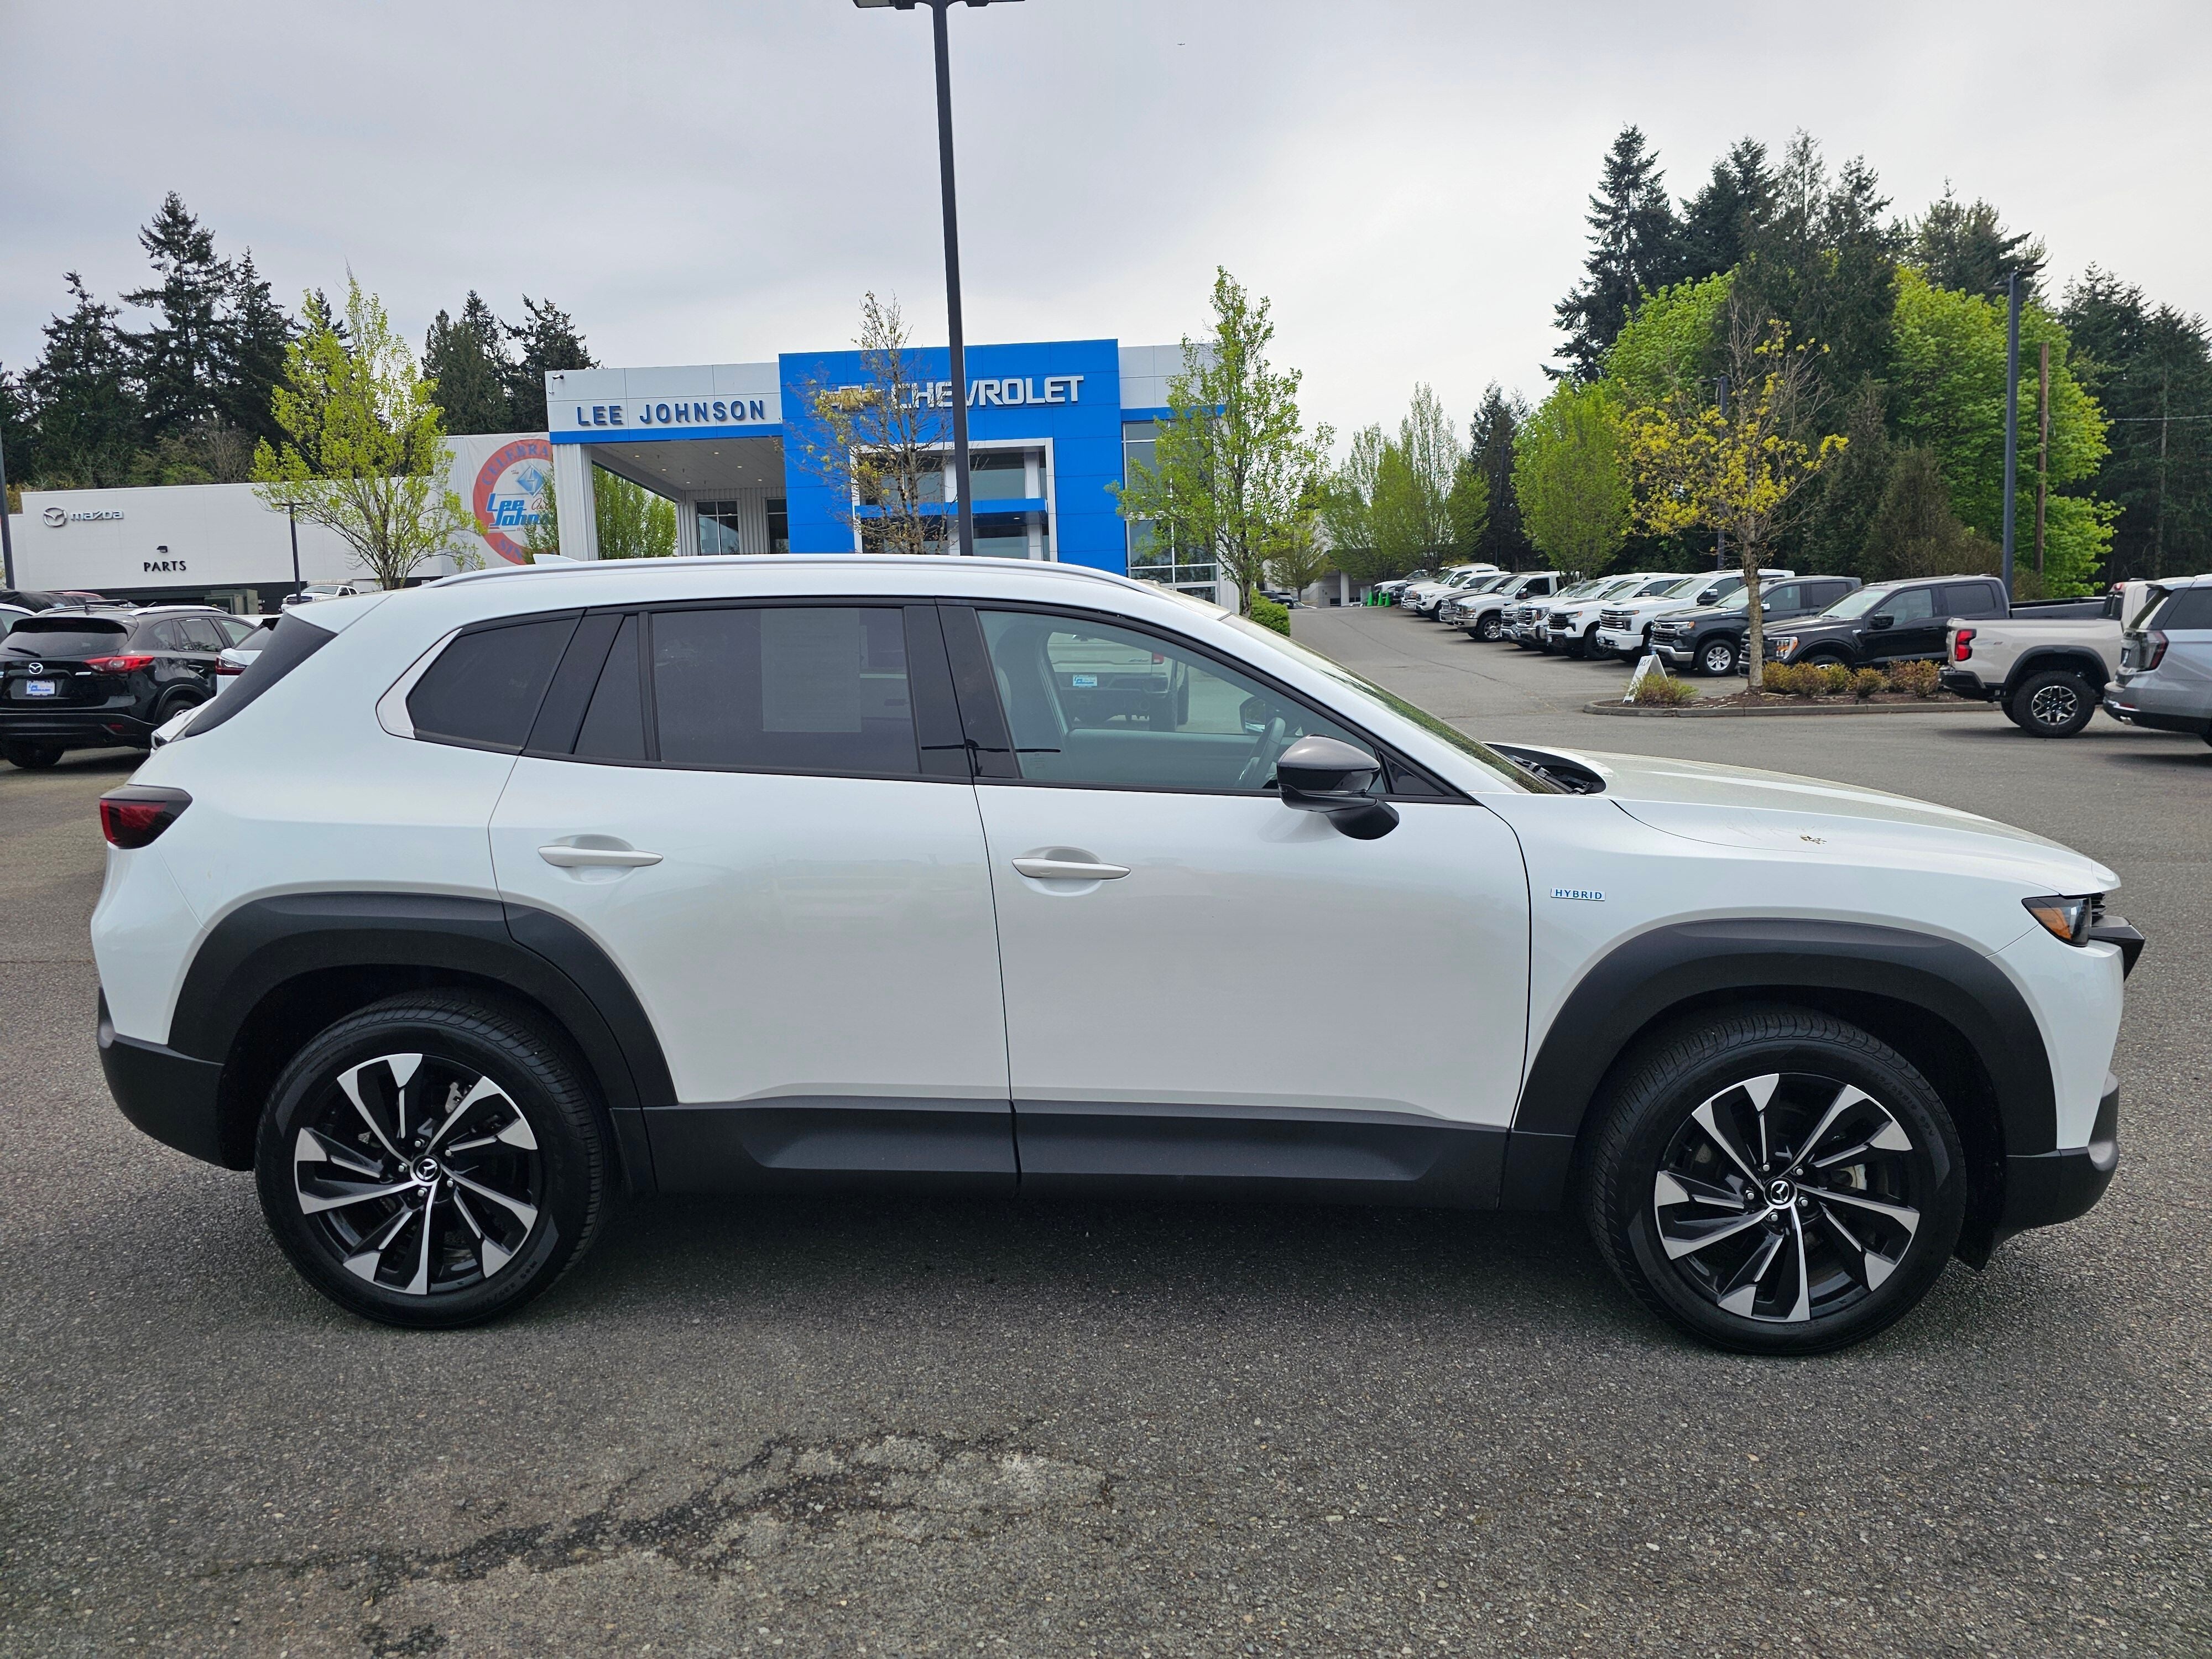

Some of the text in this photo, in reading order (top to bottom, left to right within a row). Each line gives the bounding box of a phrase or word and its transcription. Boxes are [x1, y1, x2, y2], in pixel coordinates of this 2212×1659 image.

[890, 375, 1084, 409] CHEVROLET
[577, 400, 765, 426] LEE JOHNSON
[486, 493, 526, 512] Lee
[70, 509, 124, 521] mazda
[143, 561, 186, 572] PARTS
[1555, 889, 1603, 900] HYBRID
